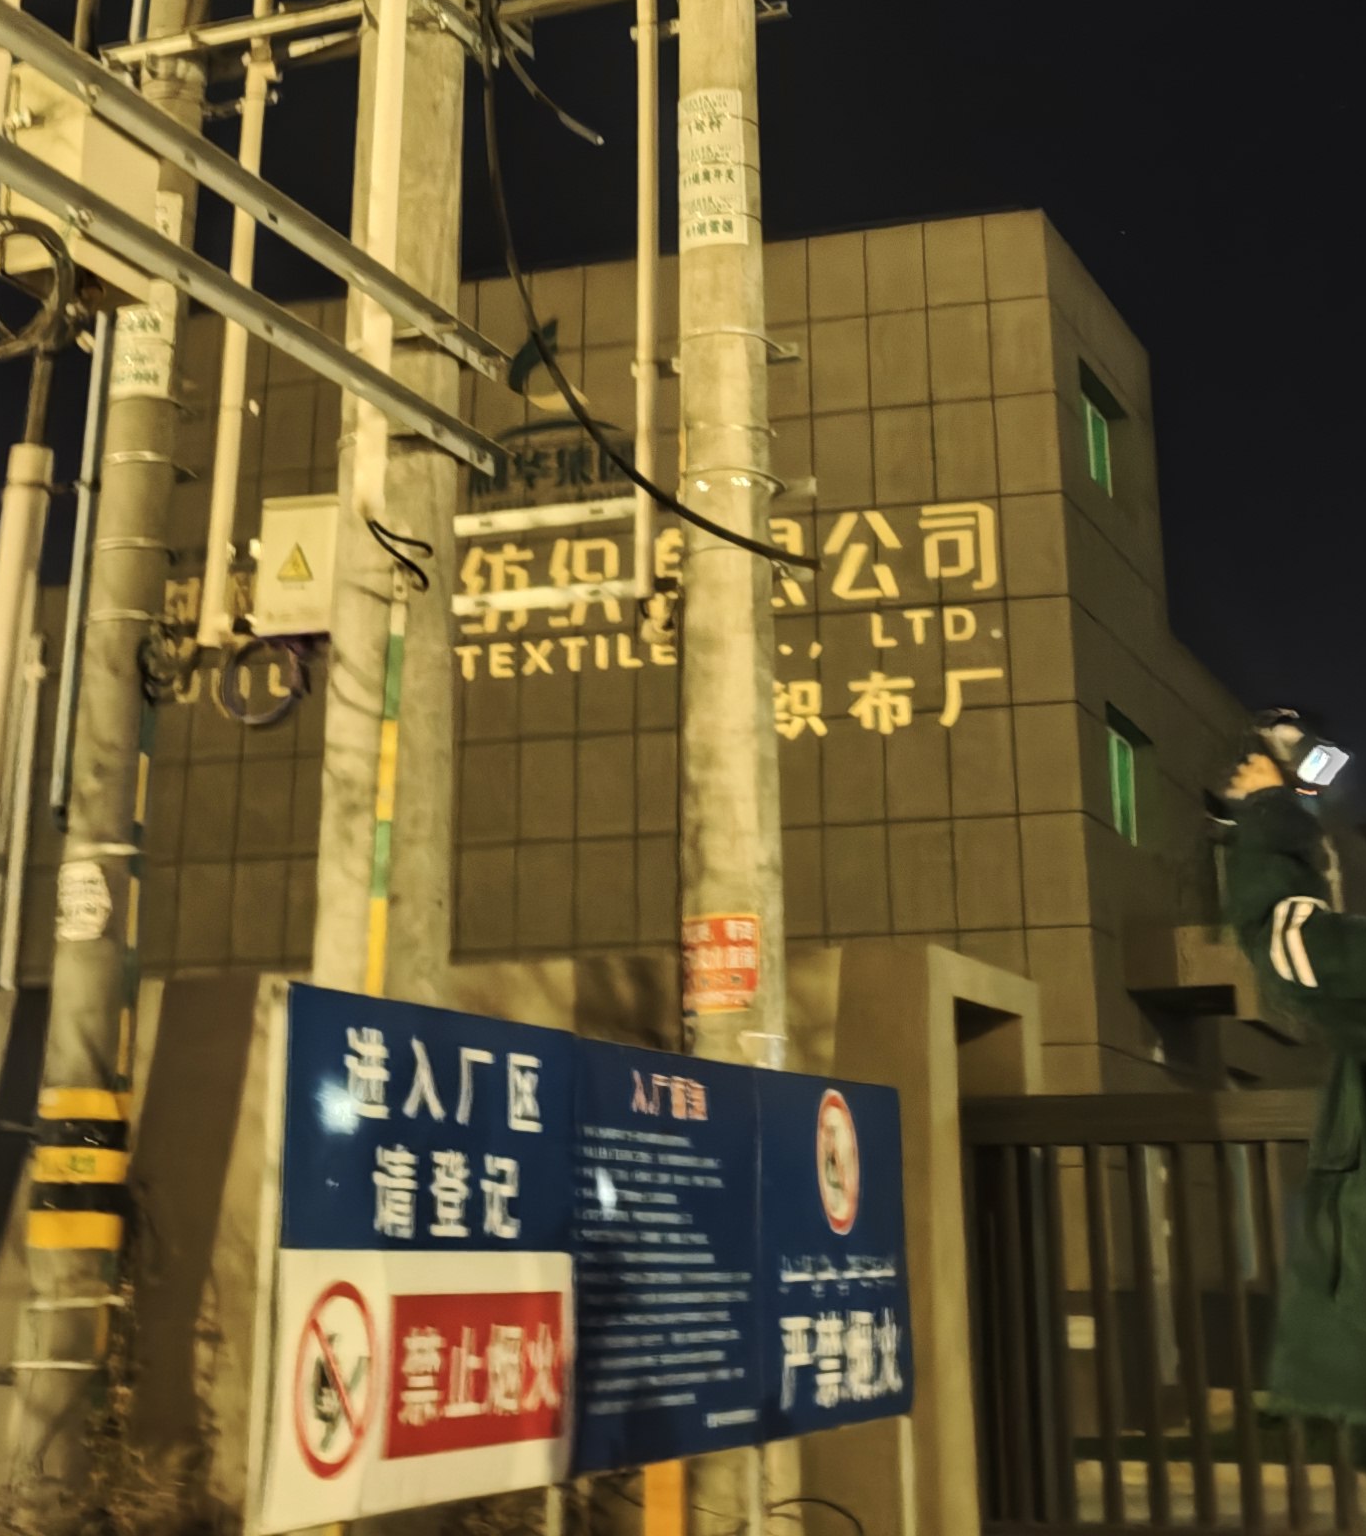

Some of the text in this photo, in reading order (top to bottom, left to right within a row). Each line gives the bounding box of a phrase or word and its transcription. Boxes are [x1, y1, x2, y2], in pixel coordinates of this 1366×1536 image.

[454, 606, 1003, 681] TEXTILE LTD.
[343, 1026, 544, 1134] 进入厂区
[371, 1143, 522, 1240] 请登记
[397, 1322, 561, 1427] 禁止烟火
